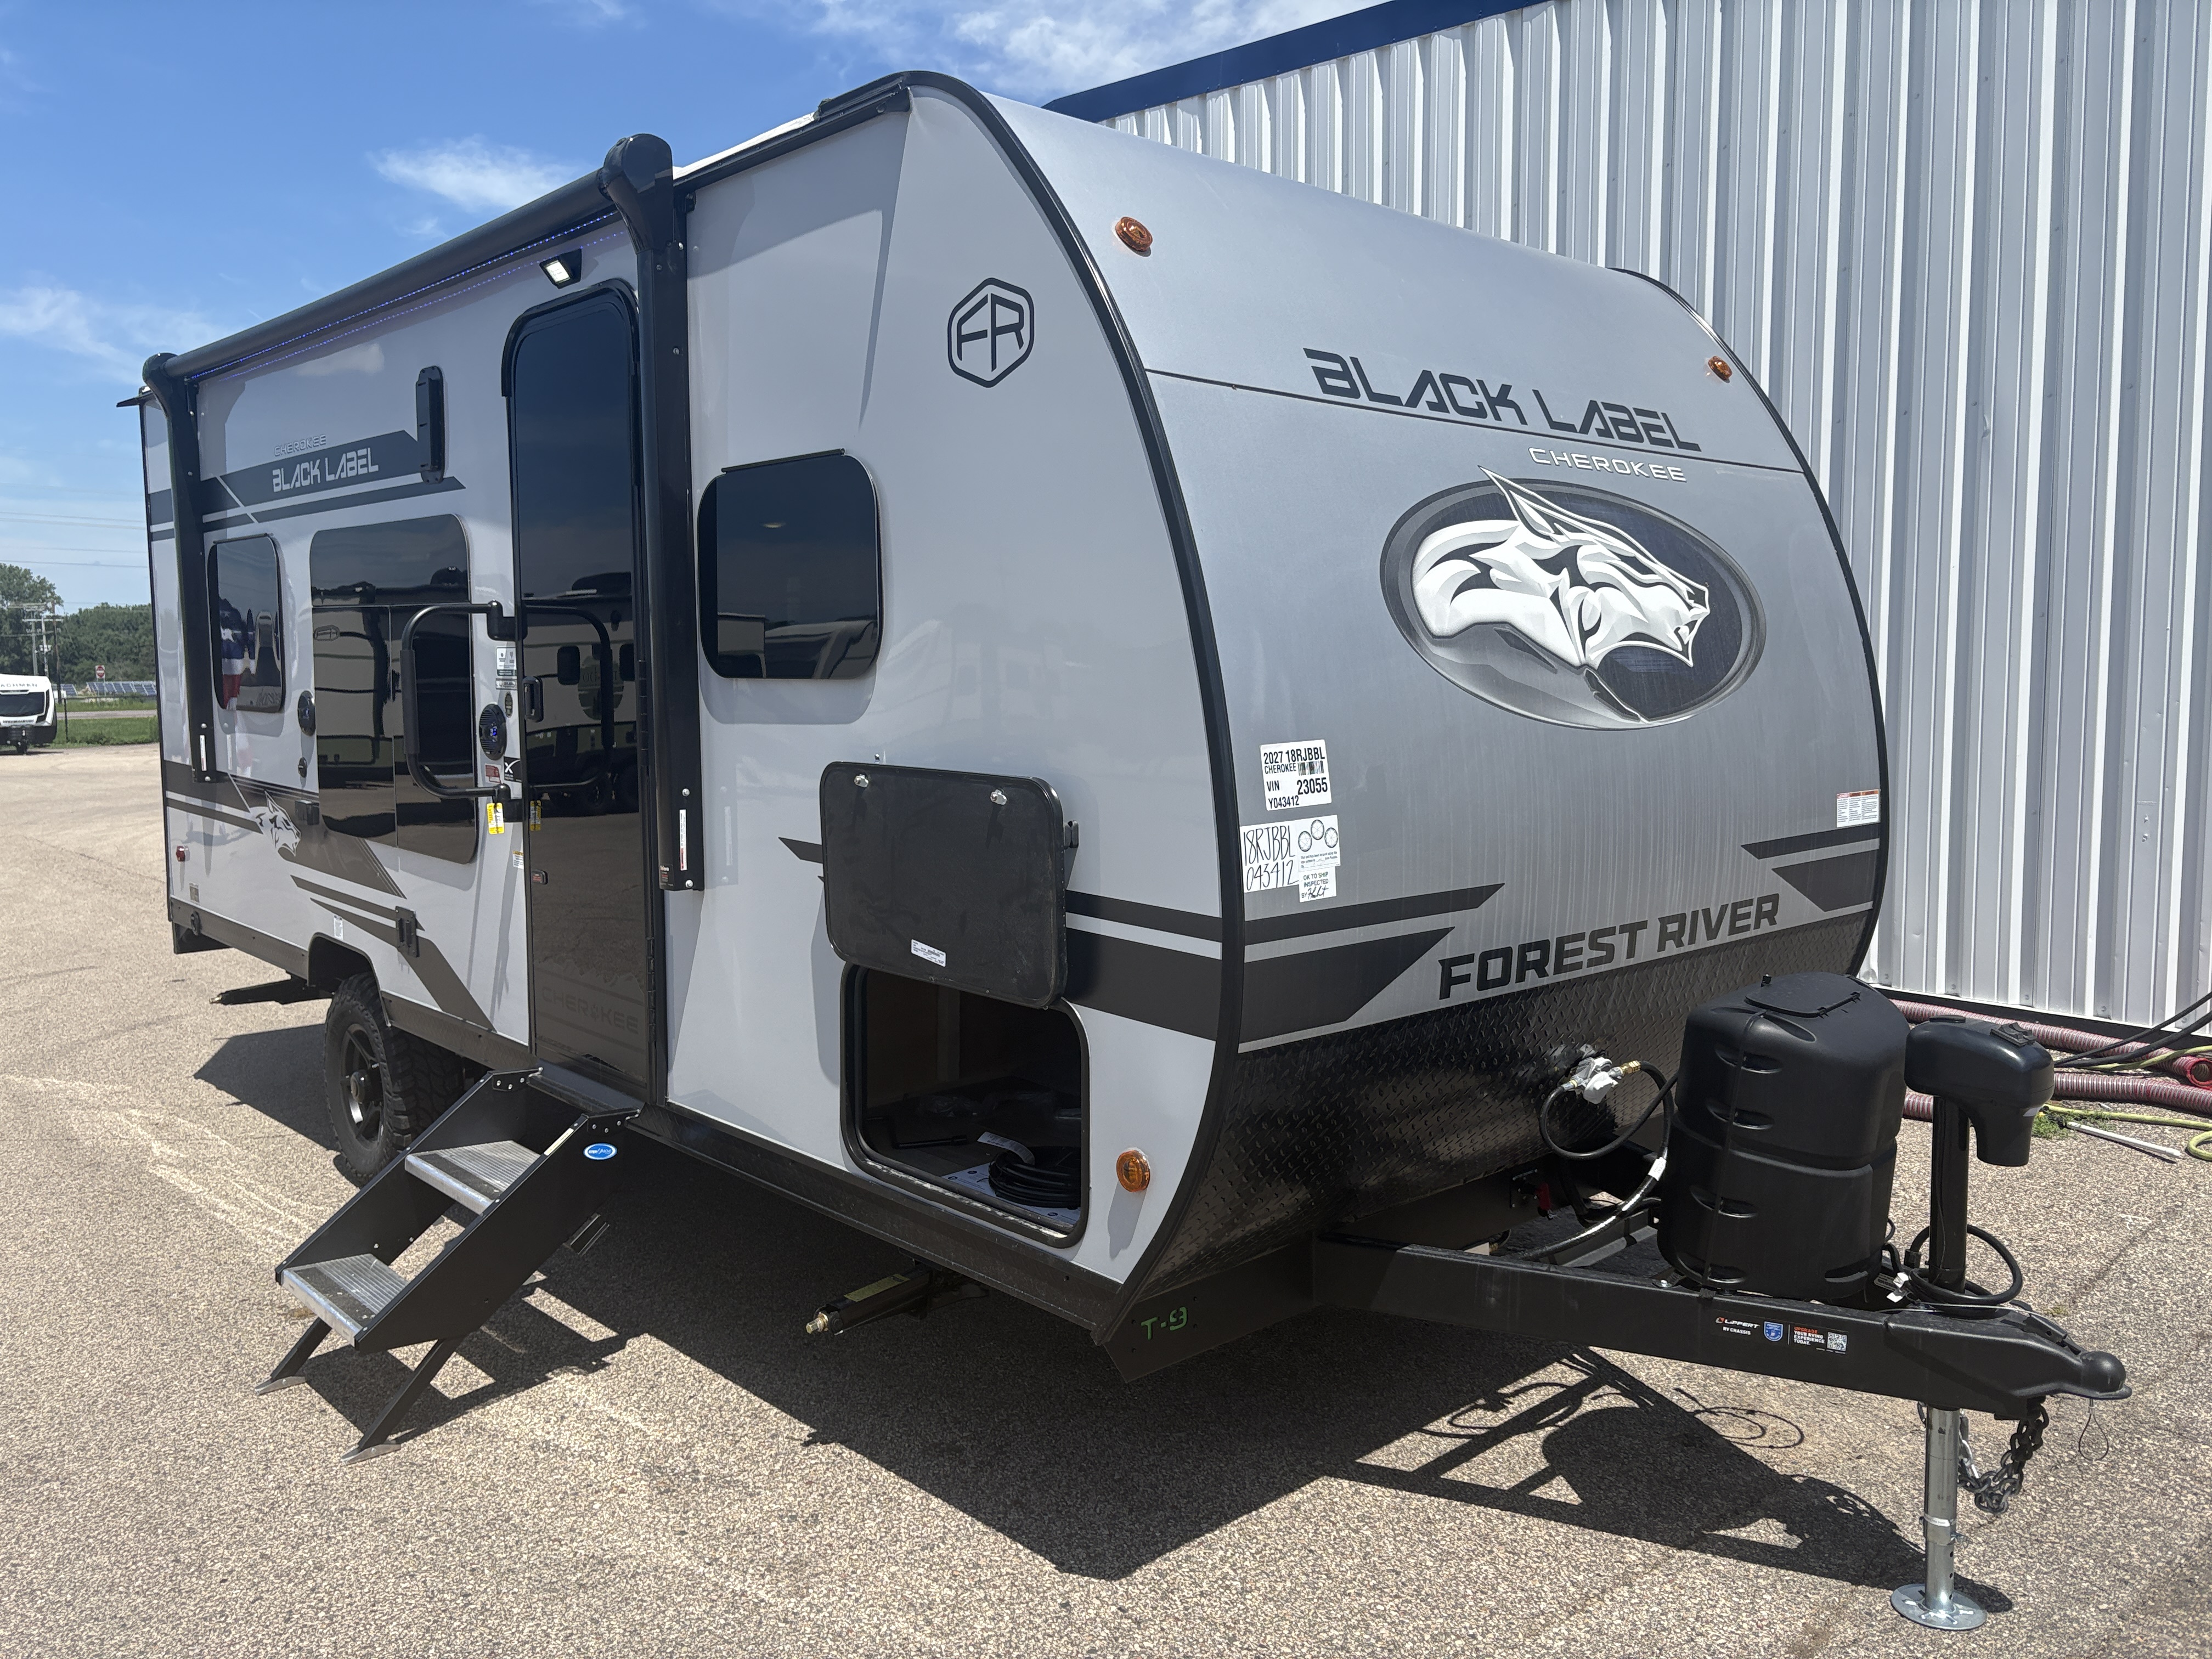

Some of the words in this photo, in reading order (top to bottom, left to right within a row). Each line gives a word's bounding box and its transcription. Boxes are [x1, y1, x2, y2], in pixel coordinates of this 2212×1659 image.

[1302, 347, 1528, 426] BLACK
[1532, 389, 1702, 453] LABEL
[274, 434, 326, 457] CHEROKEE
[272, 459, 321, 493] BLACK
[325, 447, 379, 482] LABEL
[1528, 447, 1688, 483] CHEROKEE
[1263, 751, 1283, 765] 2027
[1285, 747, 1325, 763] 18RJBBL
[1264, 763, 1297, 775] CHEROKEE
[1266, 780, 1280, 792] VIN
[1296, 777, 1328, 795] 23055
[1268, 795, 1300, 809] Y043412
[1304, 878, 1329, 888] INSPECTED
[1438, 920, 1648, 1000] FOREST
[1657, 893, 1780, 953] RIVER
